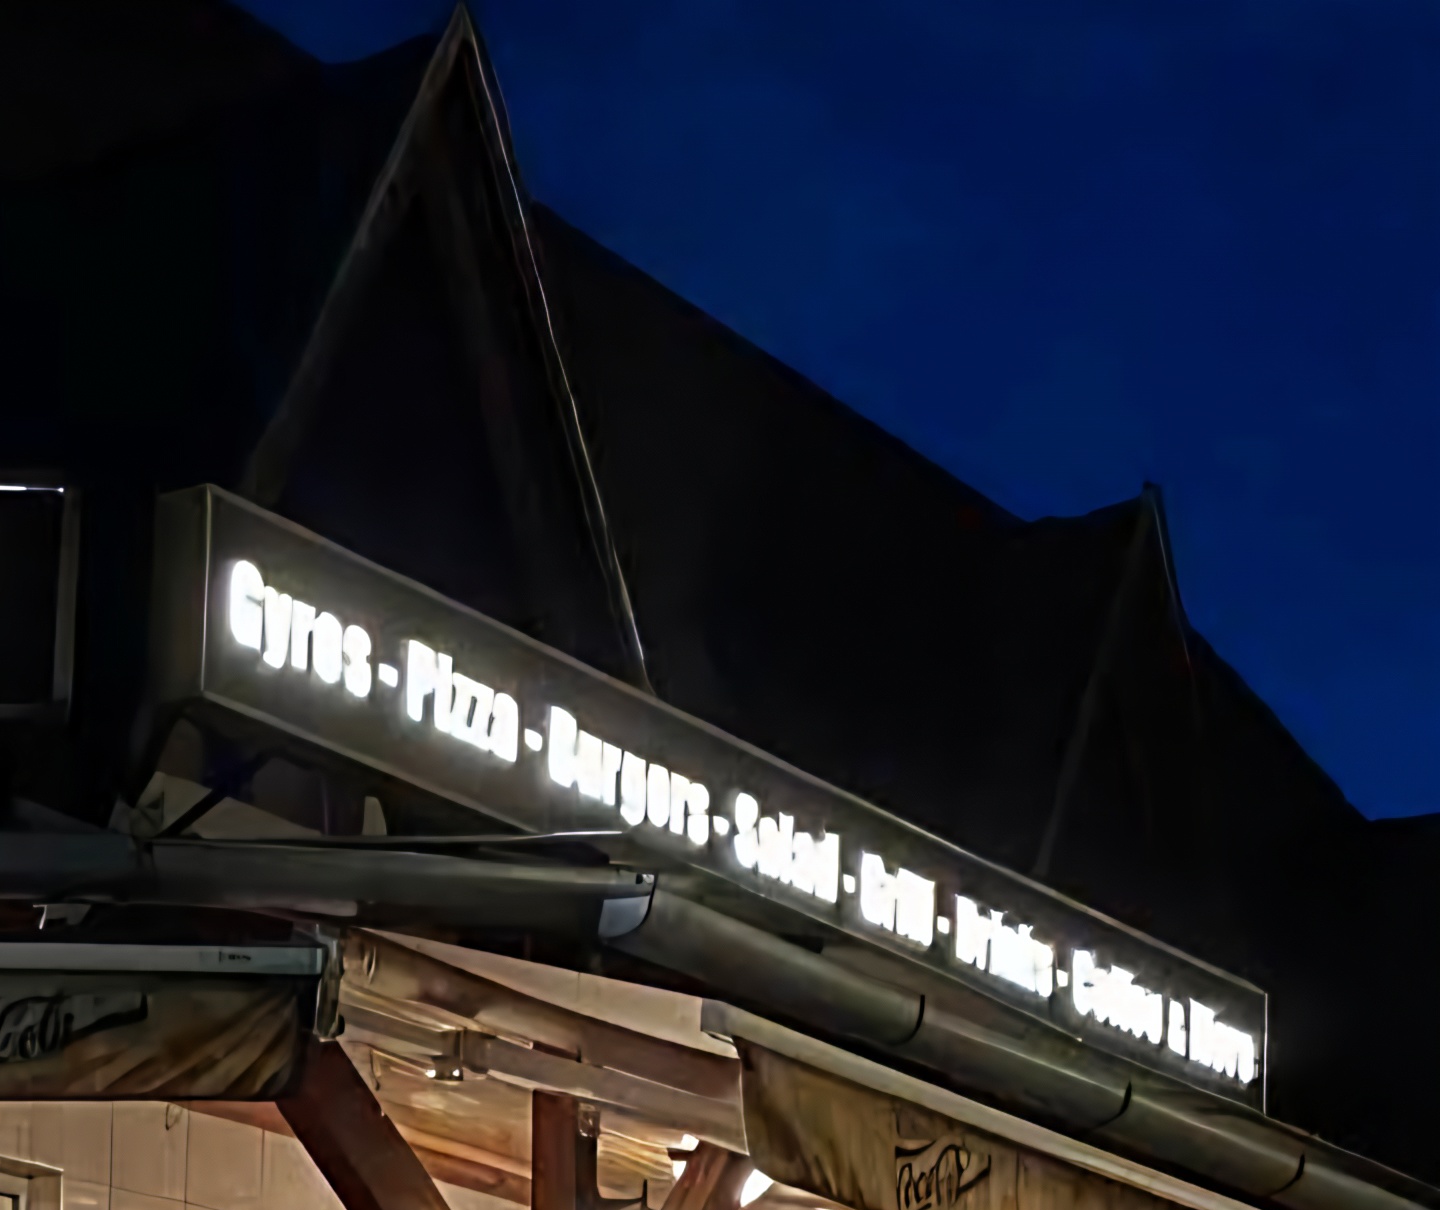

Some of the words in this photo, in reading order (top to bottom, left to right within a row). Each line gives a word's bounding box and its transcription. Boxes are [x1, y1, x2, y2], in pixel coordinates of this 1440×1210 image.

[226, 560, 372, 699] Gyros
[404, 640, 518, 763] Pizza
[547, 706, 709, 847] Burgers
[734, 793, 839, 903] Salad
